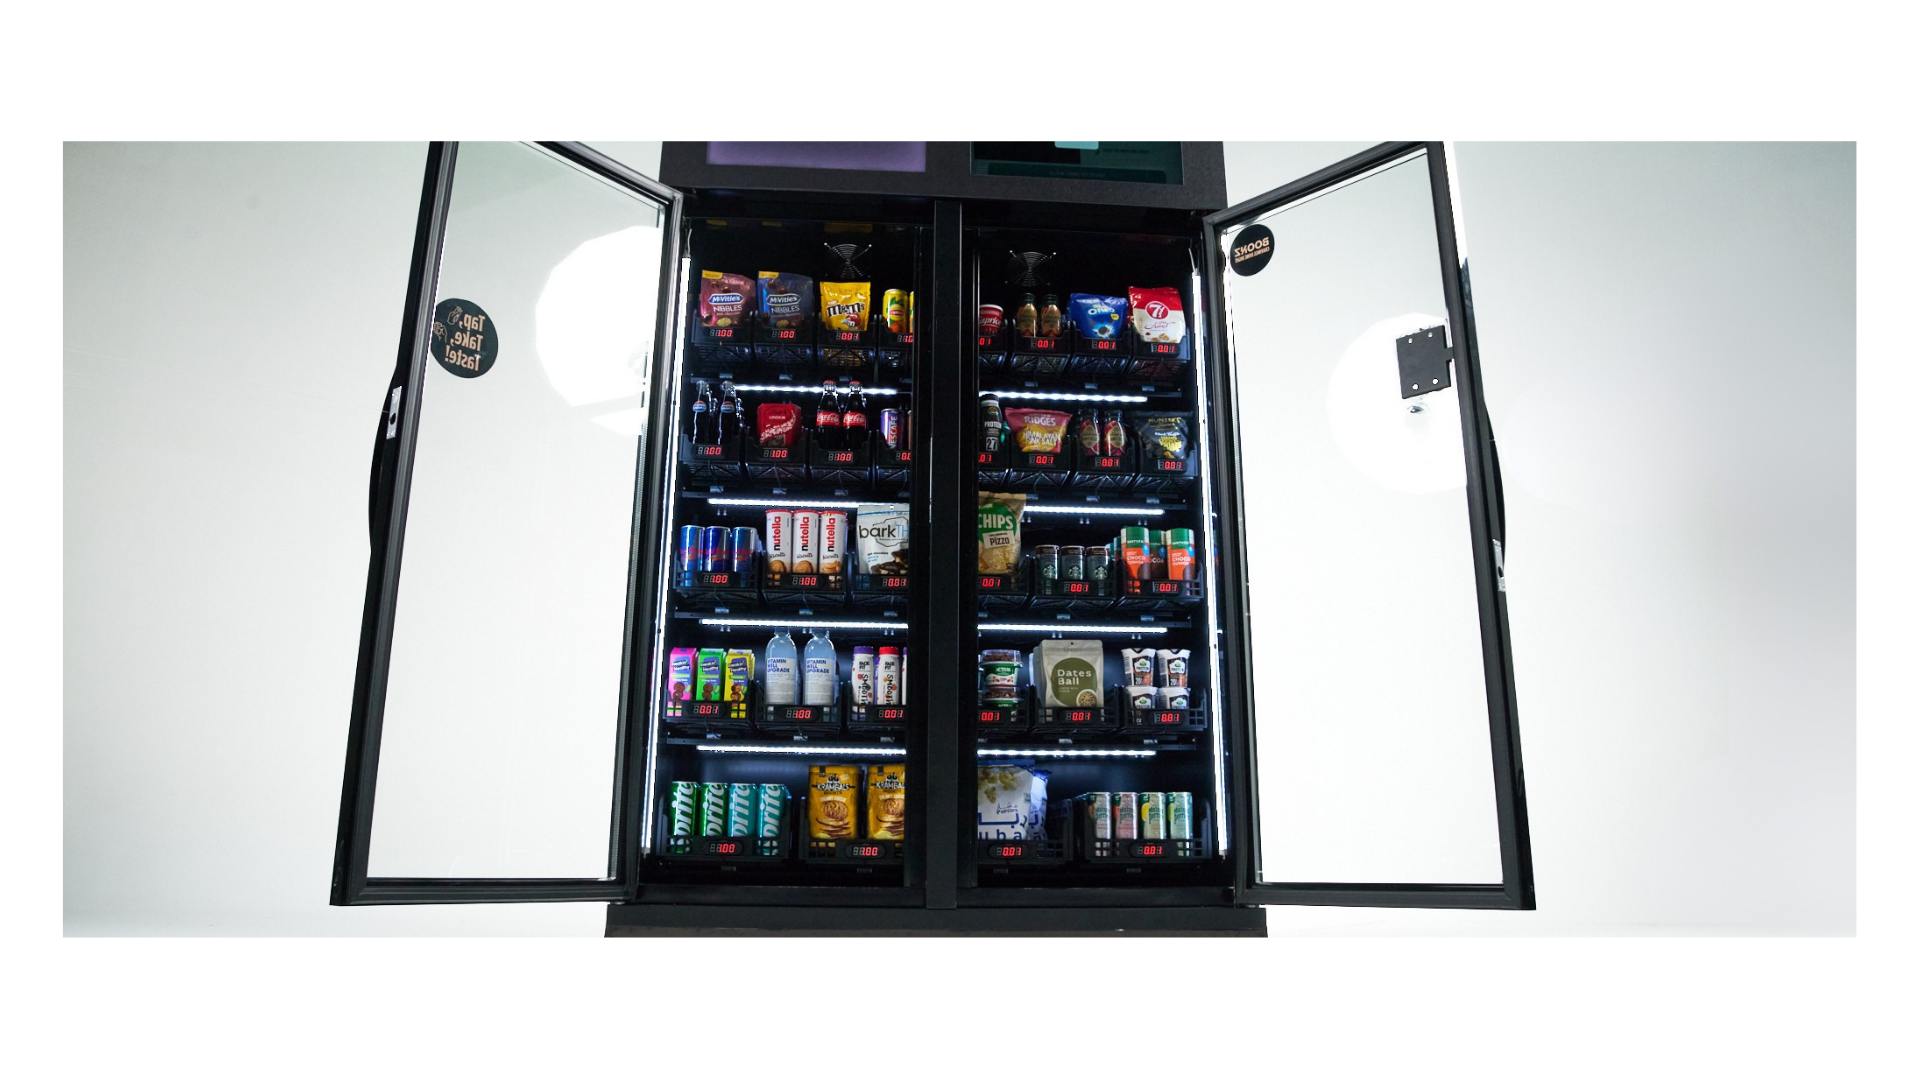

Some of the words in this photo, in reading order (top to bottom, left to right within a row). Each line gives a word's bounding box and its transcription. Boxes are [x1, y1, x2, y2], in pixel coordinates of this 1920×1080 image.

[713, 305, 742, 313] NIBBLES
[771, 305, 800, 314] NIBBLES
[1024, 415, 1056, 427] RIDGES
[1041, 437, 1057, 446] SALT
[772, 516, 781, 551] nutella
[800, 516, 809, 551] nutella
[826, 517, 836, 552] nutella
[1057, 669, 1092, 677] Dates
[1058, 677, 1079, 685] Ball
